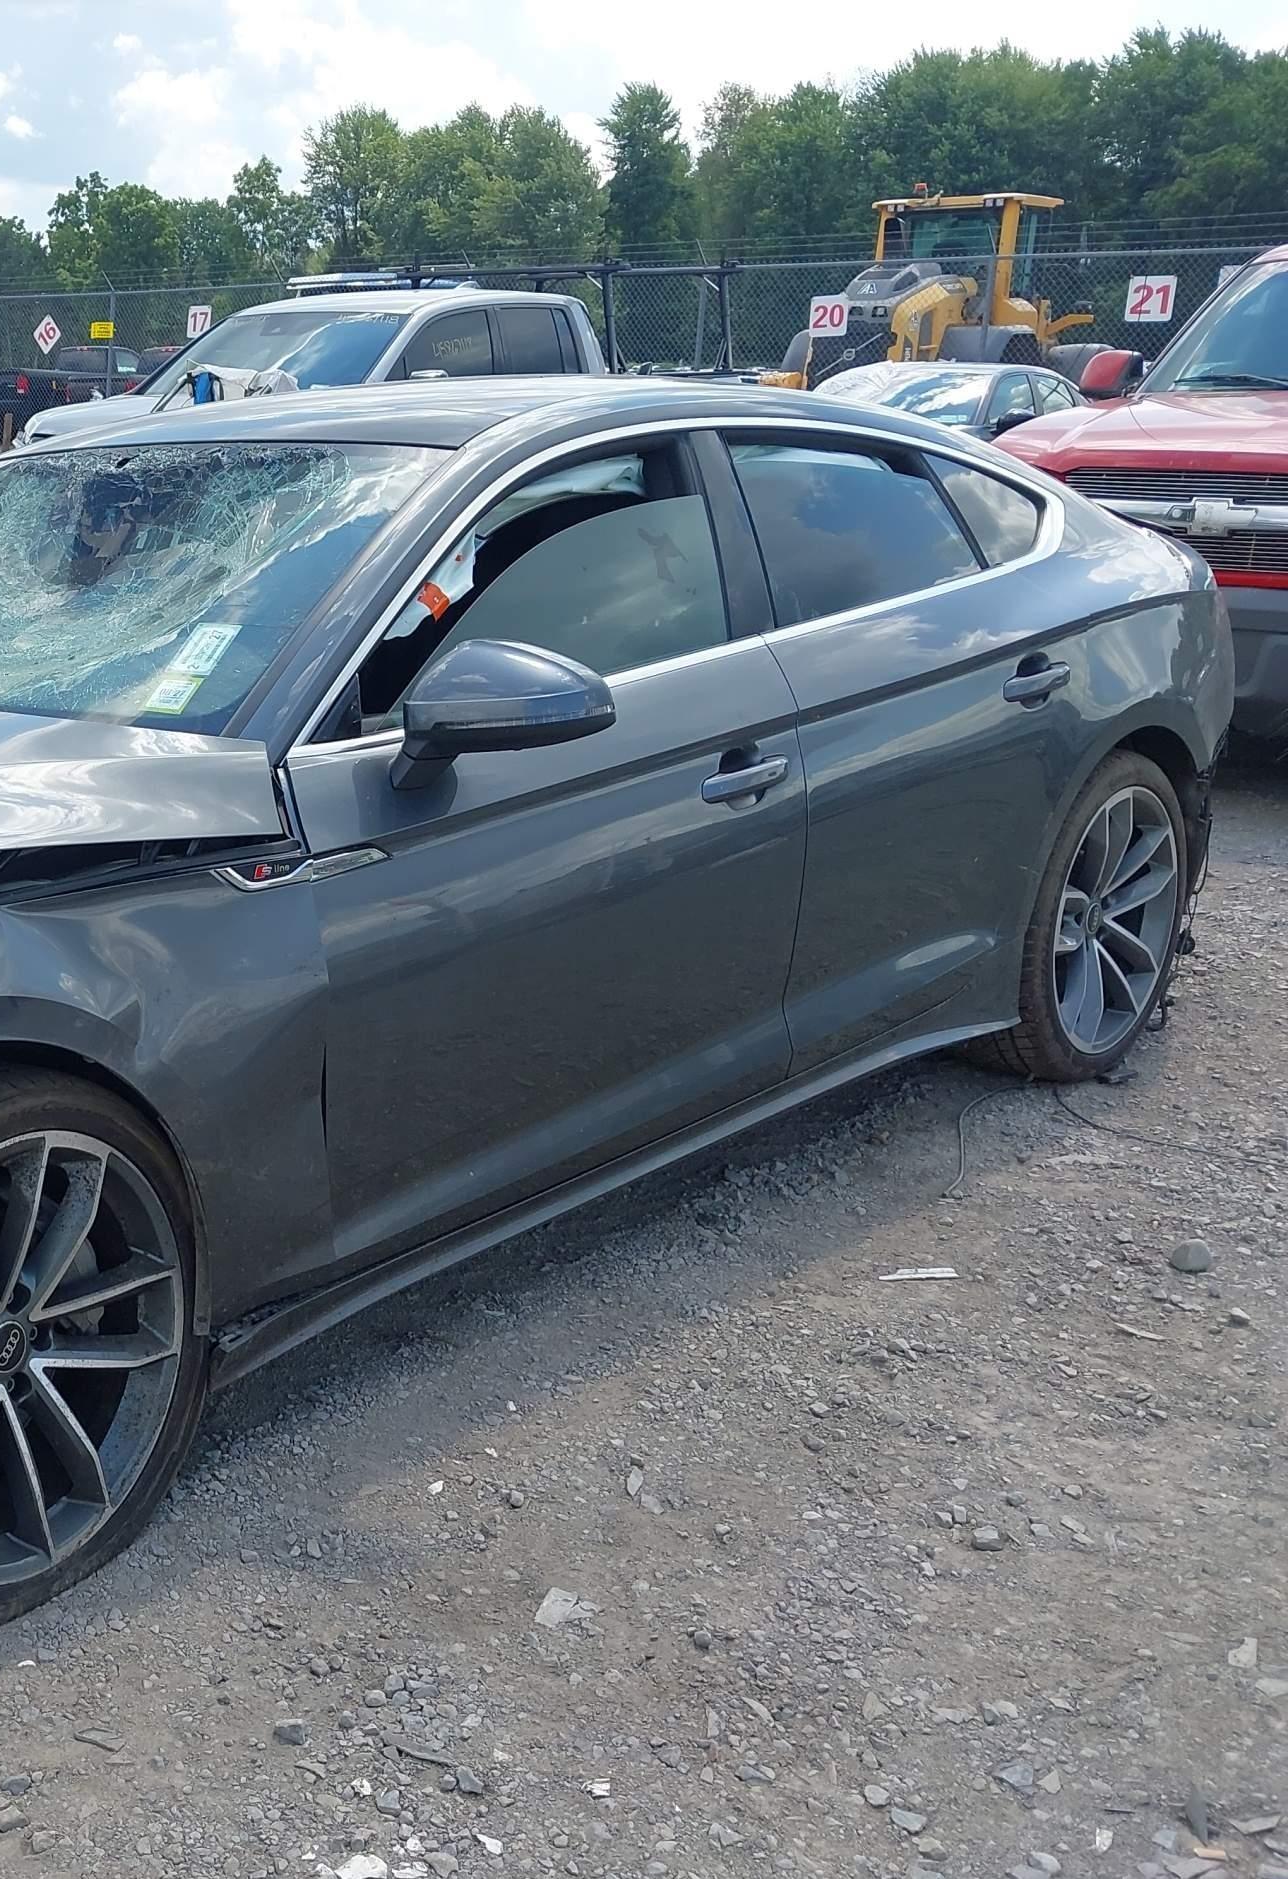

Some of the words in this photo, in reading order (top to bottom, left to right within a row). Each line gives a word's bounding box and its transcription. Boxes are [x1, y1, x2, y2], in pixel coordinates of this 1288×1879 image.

[1129, 284, 1172, 315] 21
[190, 312, 209, 333] 17
[812, 304, 844, 329] 20
[37, 322, 57, 346] 16
[274, 863, 290, 873] line
